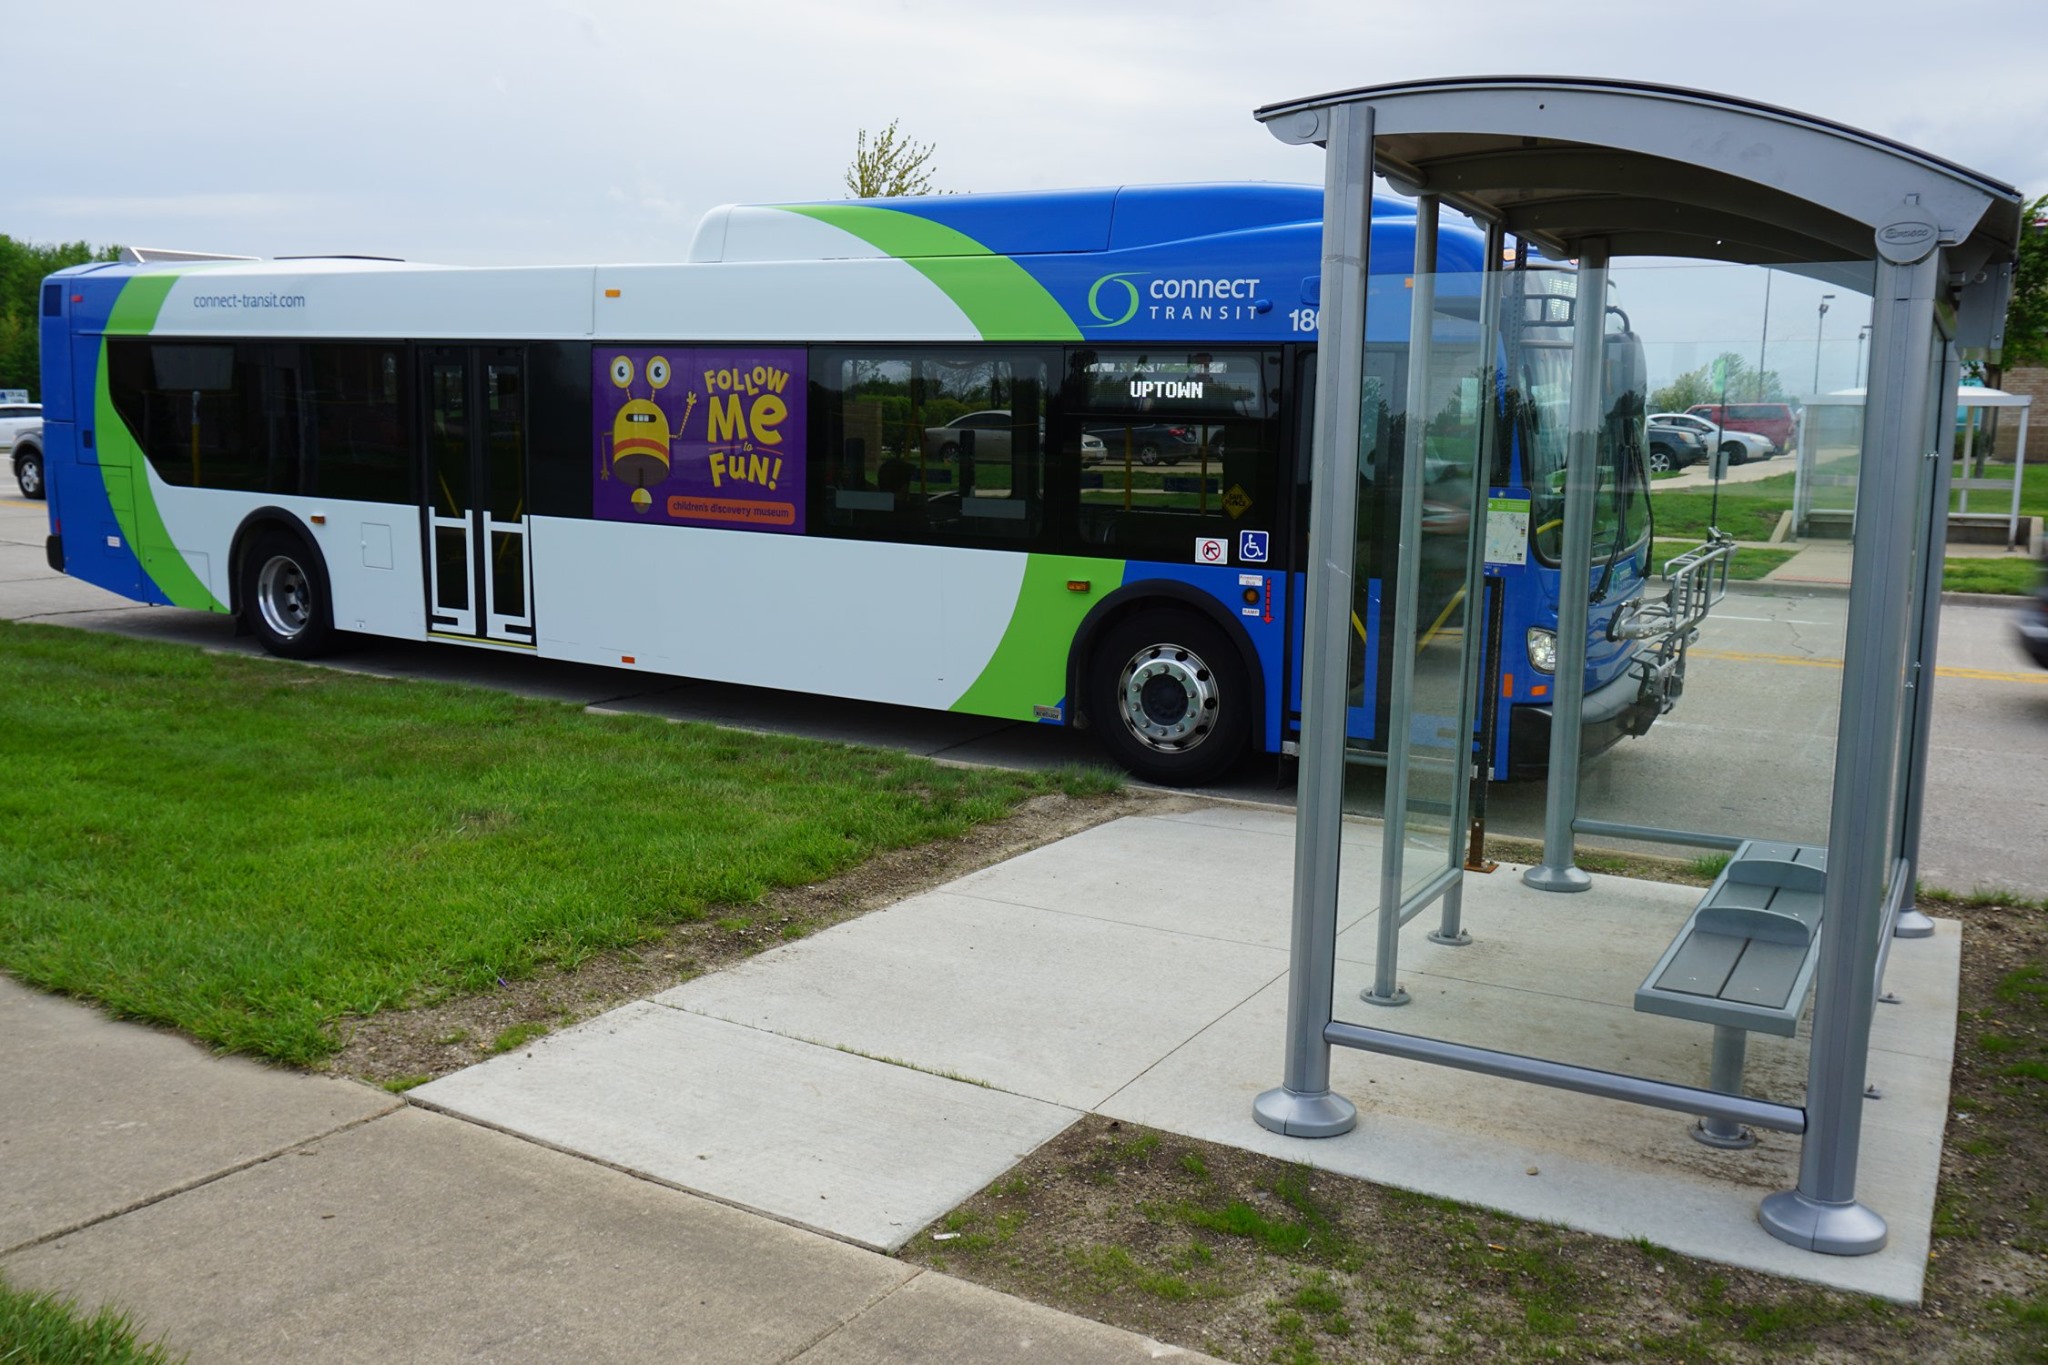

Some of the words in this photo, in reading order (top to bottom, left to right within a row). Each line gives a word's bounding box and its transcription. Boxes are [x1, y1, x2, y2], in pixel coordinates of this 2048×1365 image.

[193, 292, 305, 308] connect-transit.com
[1149, 306, 1257, 320] TRANSIT
[704, 366, 790, 396] FOLLOW
[1130, 381, 1203, 398] UPTOWN
[743, 441, 753, 451] to
[673, 501, 708, 512] children's
[711, 503, 751, 517] discovery
[753, 508, 789, 518] museum
